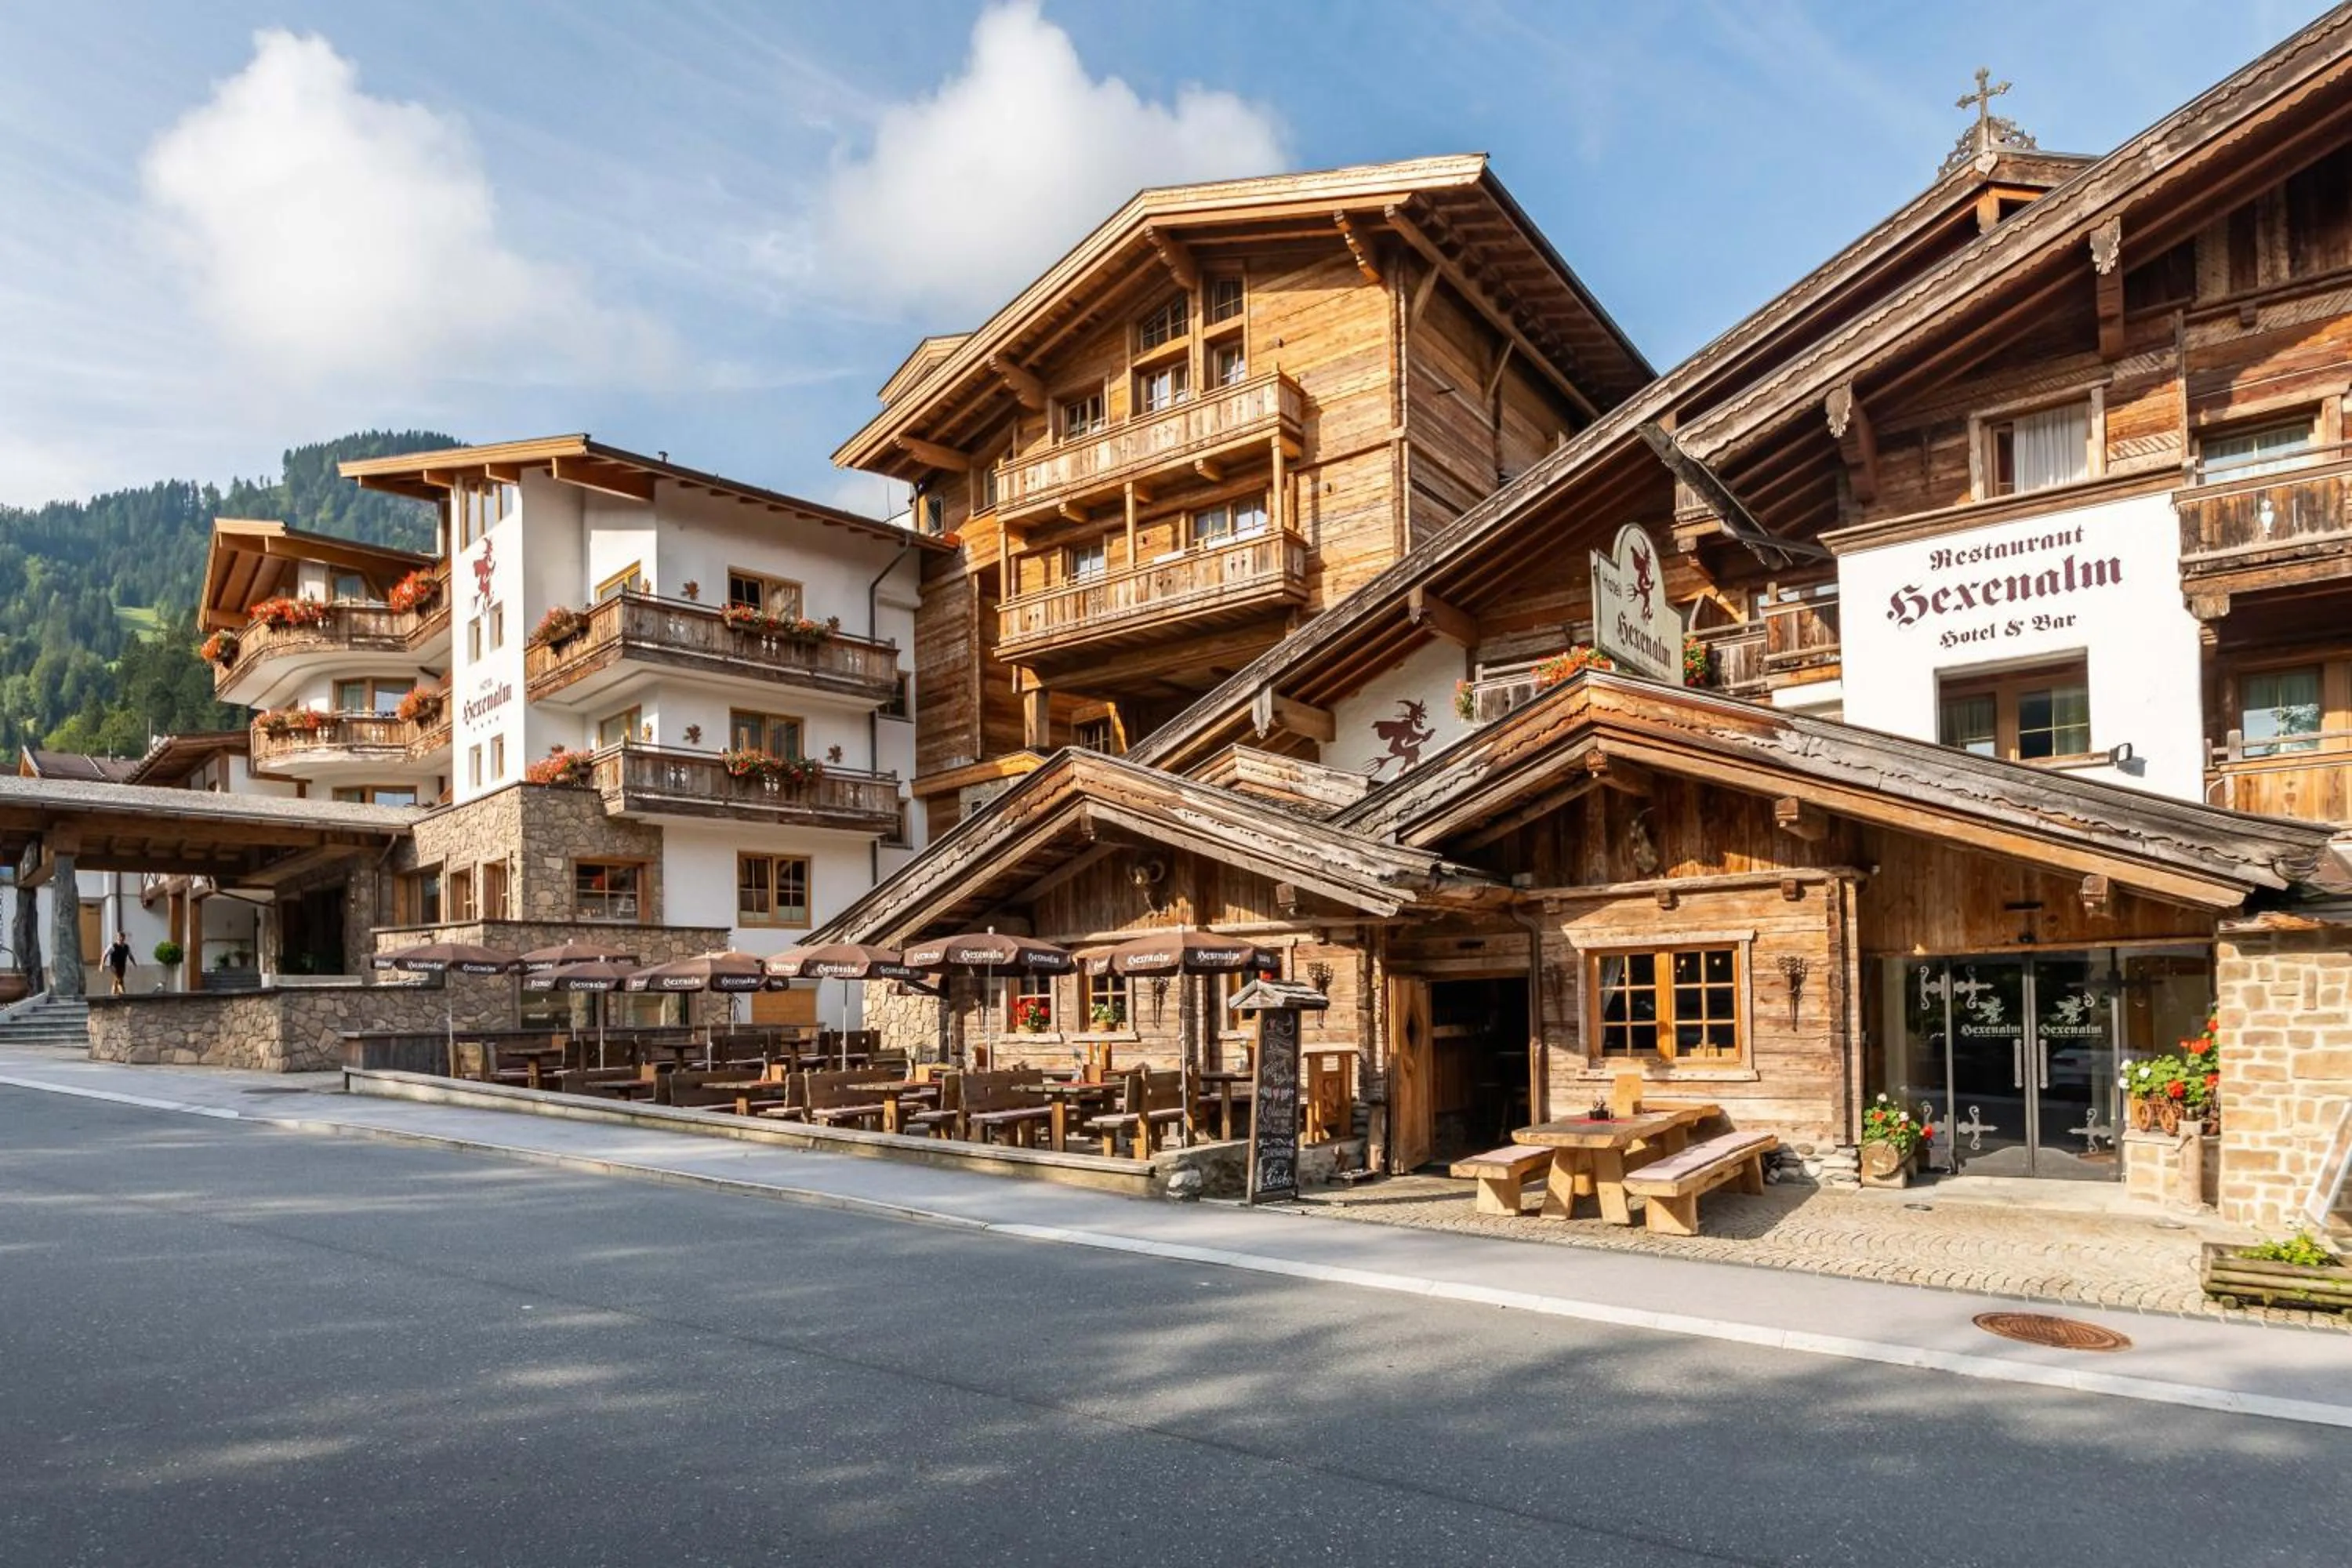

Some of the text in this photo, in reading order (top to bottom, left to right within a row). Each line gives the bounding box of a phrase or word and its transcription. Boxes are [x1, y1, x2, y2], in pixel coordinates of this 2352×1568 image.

[1929, 524, 2084, 571] Restaurant
[1886, 554, 2123, 629] Hexenalm
[1617, 611, 1671, 669] Hexenalm
[1940, 614, 2077, 648] Hotel & Bar
[463, 681, 511, 726] Hexenalm
[1960, 1023, 2022, 1036] Hexenalm
[2038, 1023, 2102, 1036] Hexenalm
